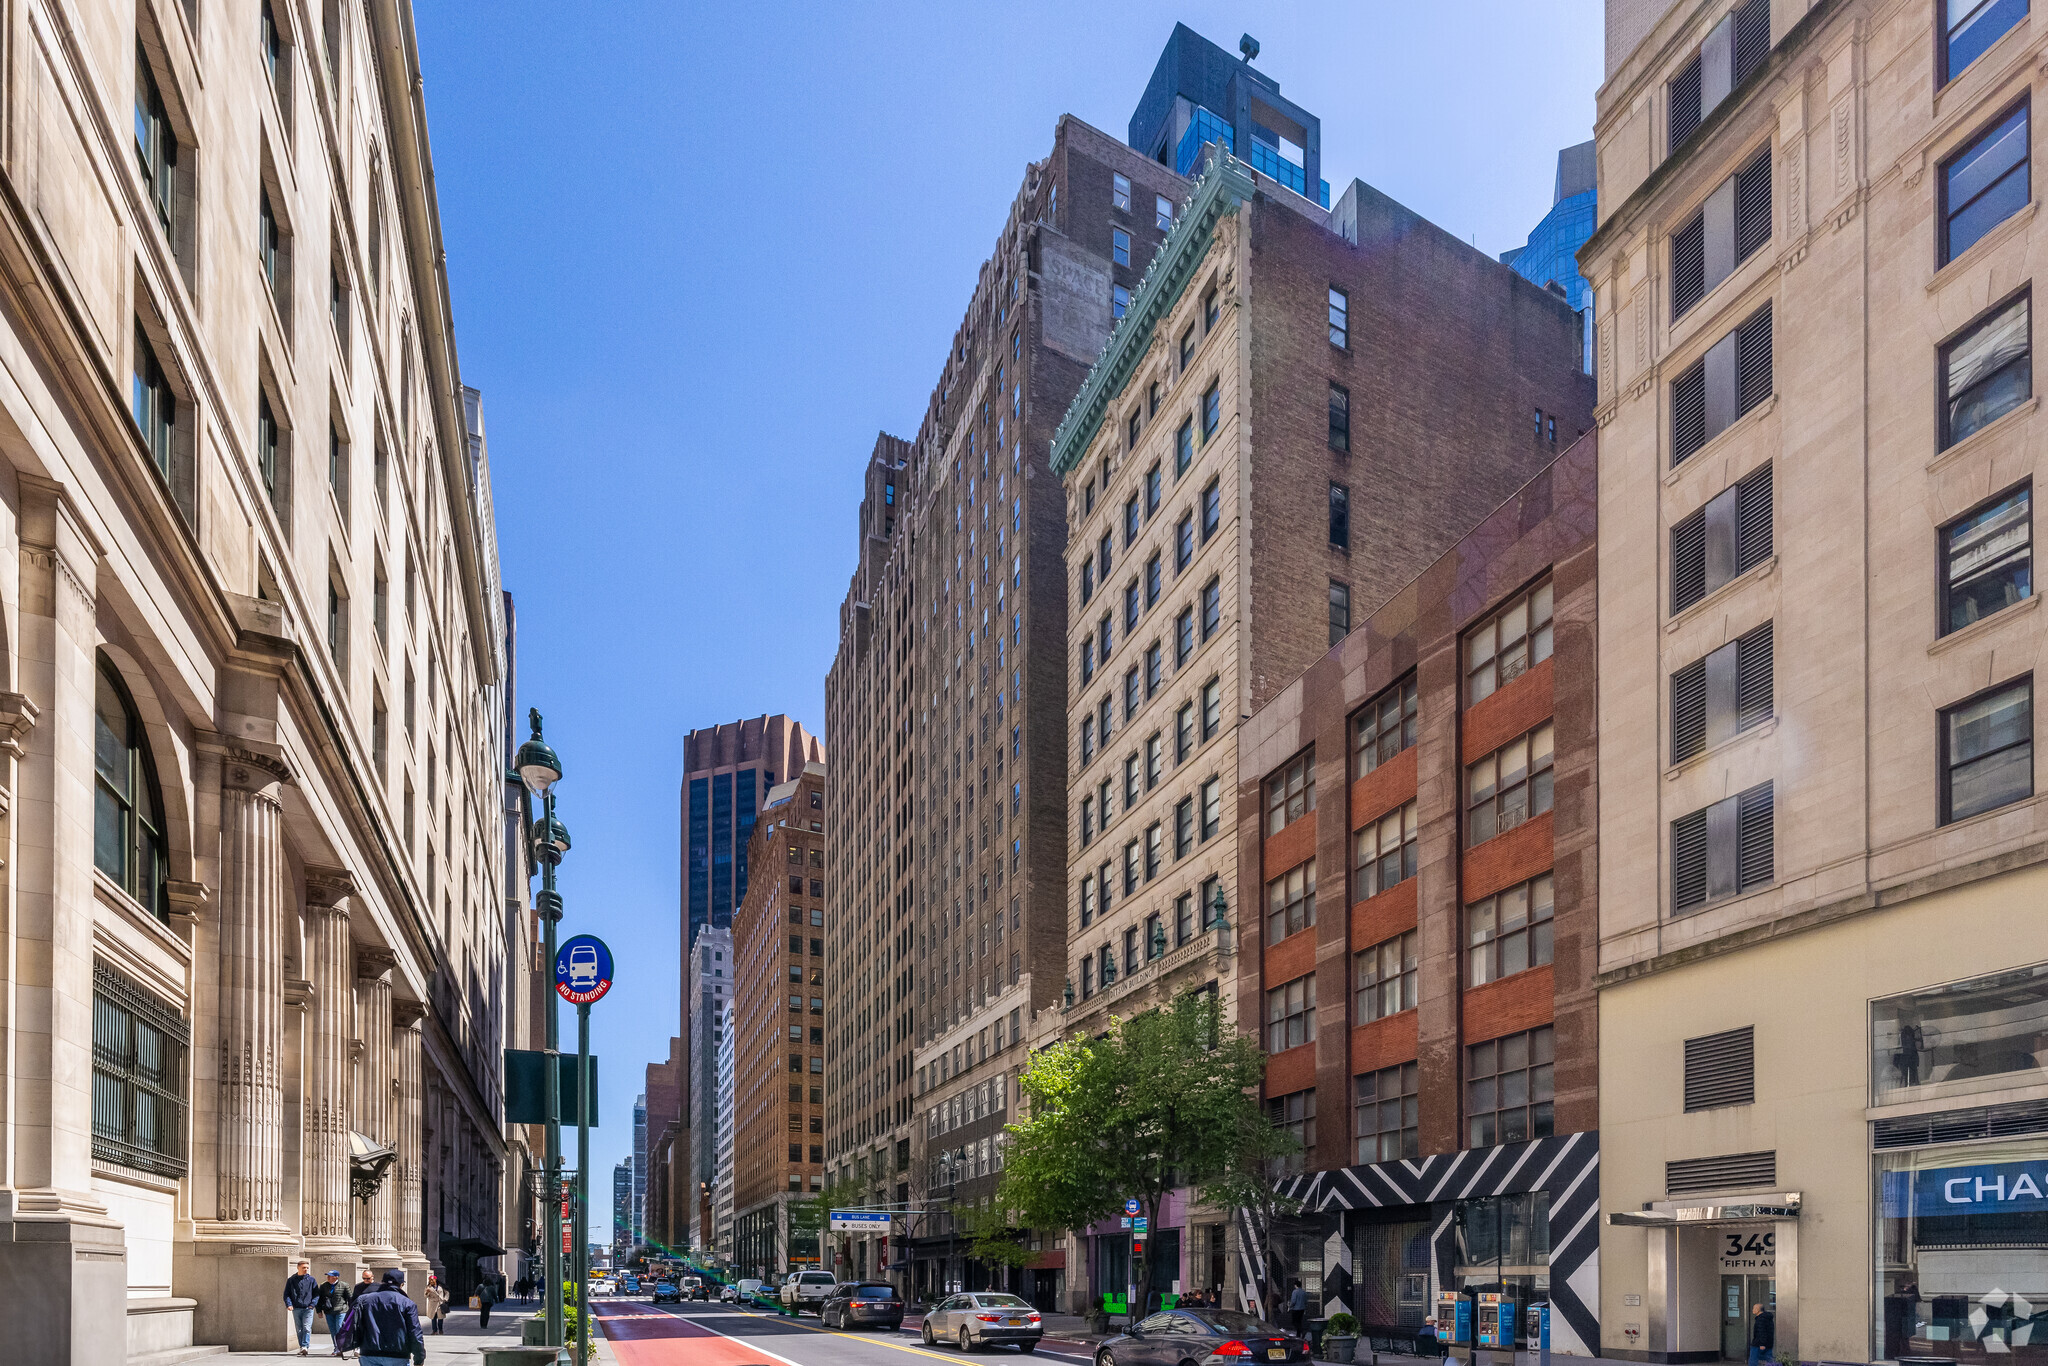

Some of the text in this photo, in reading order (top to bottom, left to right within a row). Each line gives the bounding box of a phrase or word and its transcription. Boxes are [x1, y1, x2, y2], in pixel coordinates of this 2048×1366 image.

[1051, 258, 1104, 298] SPACE
[1129, 969, 1152, 989] BUILDING
[559, 980, 608, 1002] NO STANDING
[1944, 1173, 2048, 1204] CHA
[1725, 1259, 1756, 1268] FIFTH
